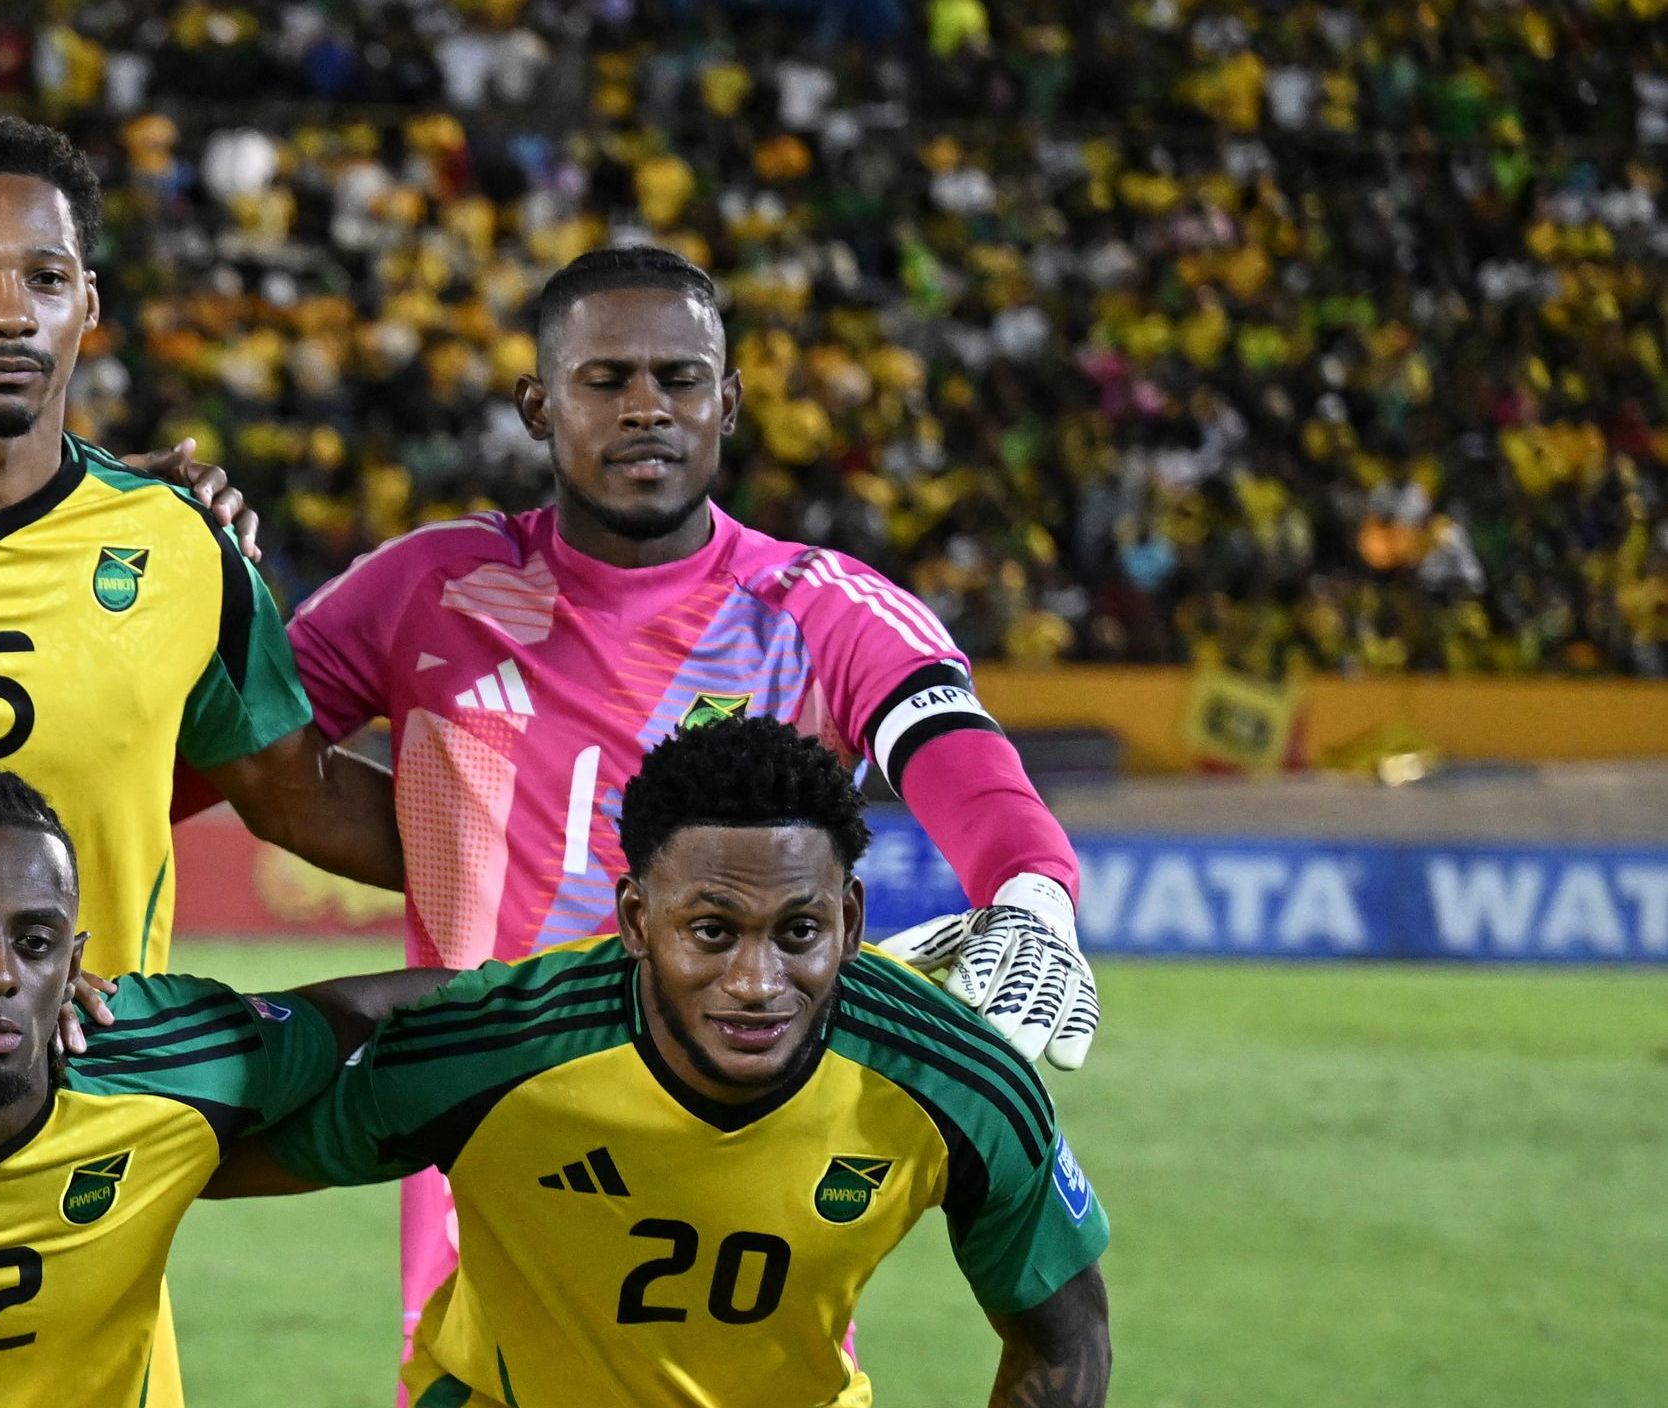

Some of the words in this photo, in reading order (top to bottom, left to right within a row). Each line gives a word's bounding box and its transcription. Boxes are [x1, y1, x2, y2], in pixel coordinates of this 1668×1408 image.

[562, 745, 601, 875] 1
[1424, 856, 1668, 955] WAT
[68, 1185, 111, 1210] JAMAICA
[820, 1187, 867, 1204] JAMAICA
[617, 1218, 791, 1325] 20
